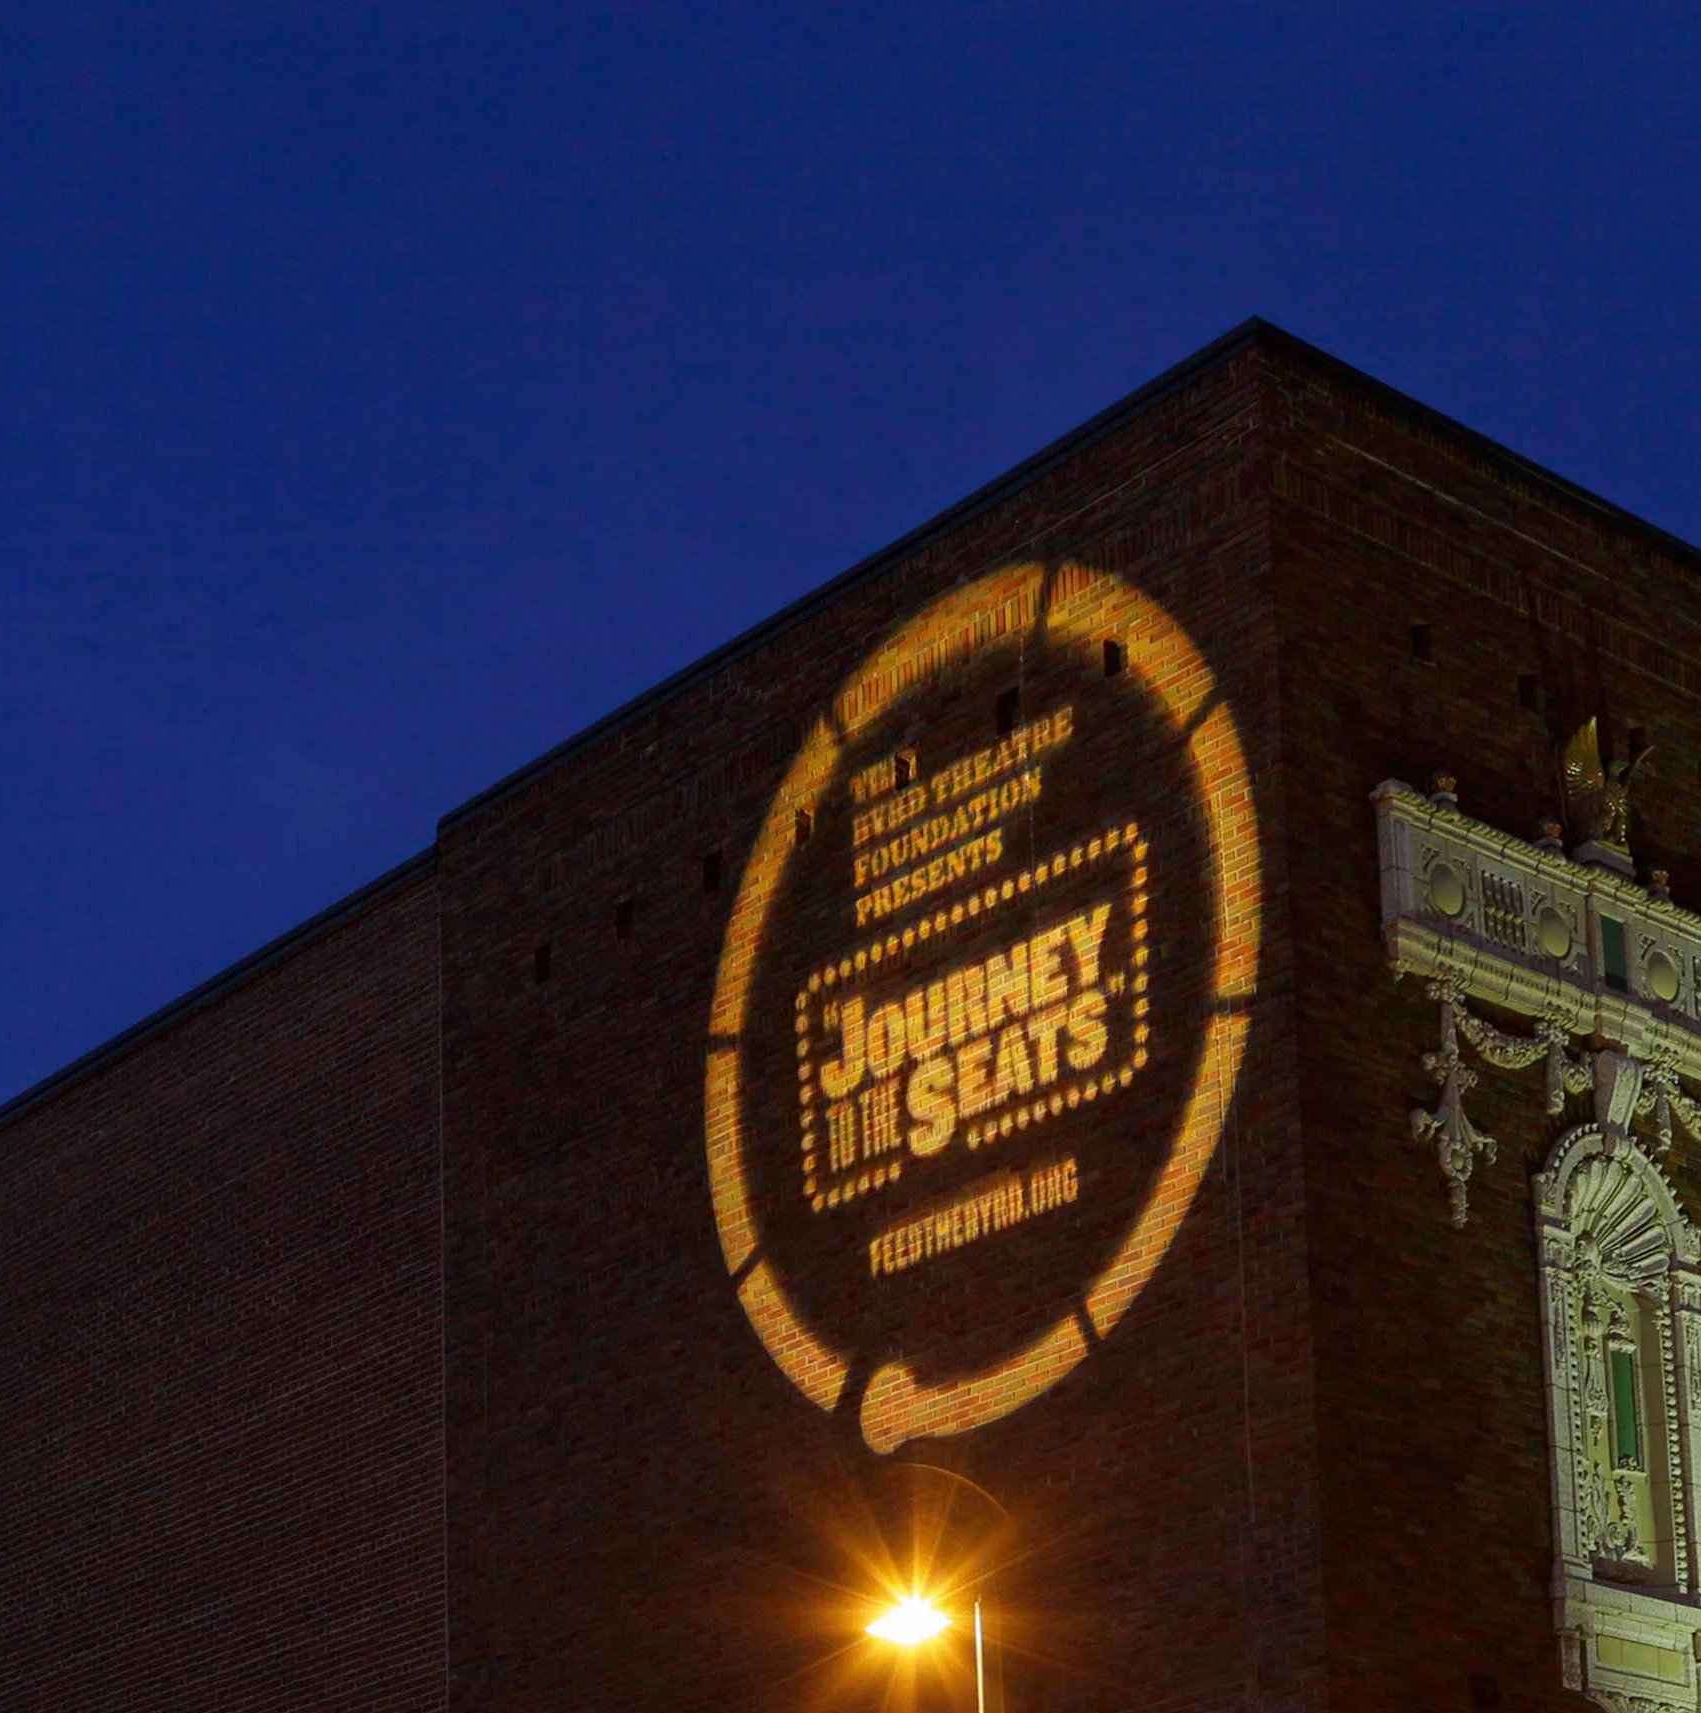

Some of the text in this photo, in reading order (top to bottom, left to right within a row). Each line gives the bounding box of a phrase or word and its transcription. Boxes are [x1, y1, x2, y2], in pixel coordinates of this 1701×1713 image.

[852, 706, 1075, 846] BYRD THEATRE
[854, 767, 1042, 889] FOUNDATION
[855, 828, 1003, 926] PRESENTS
